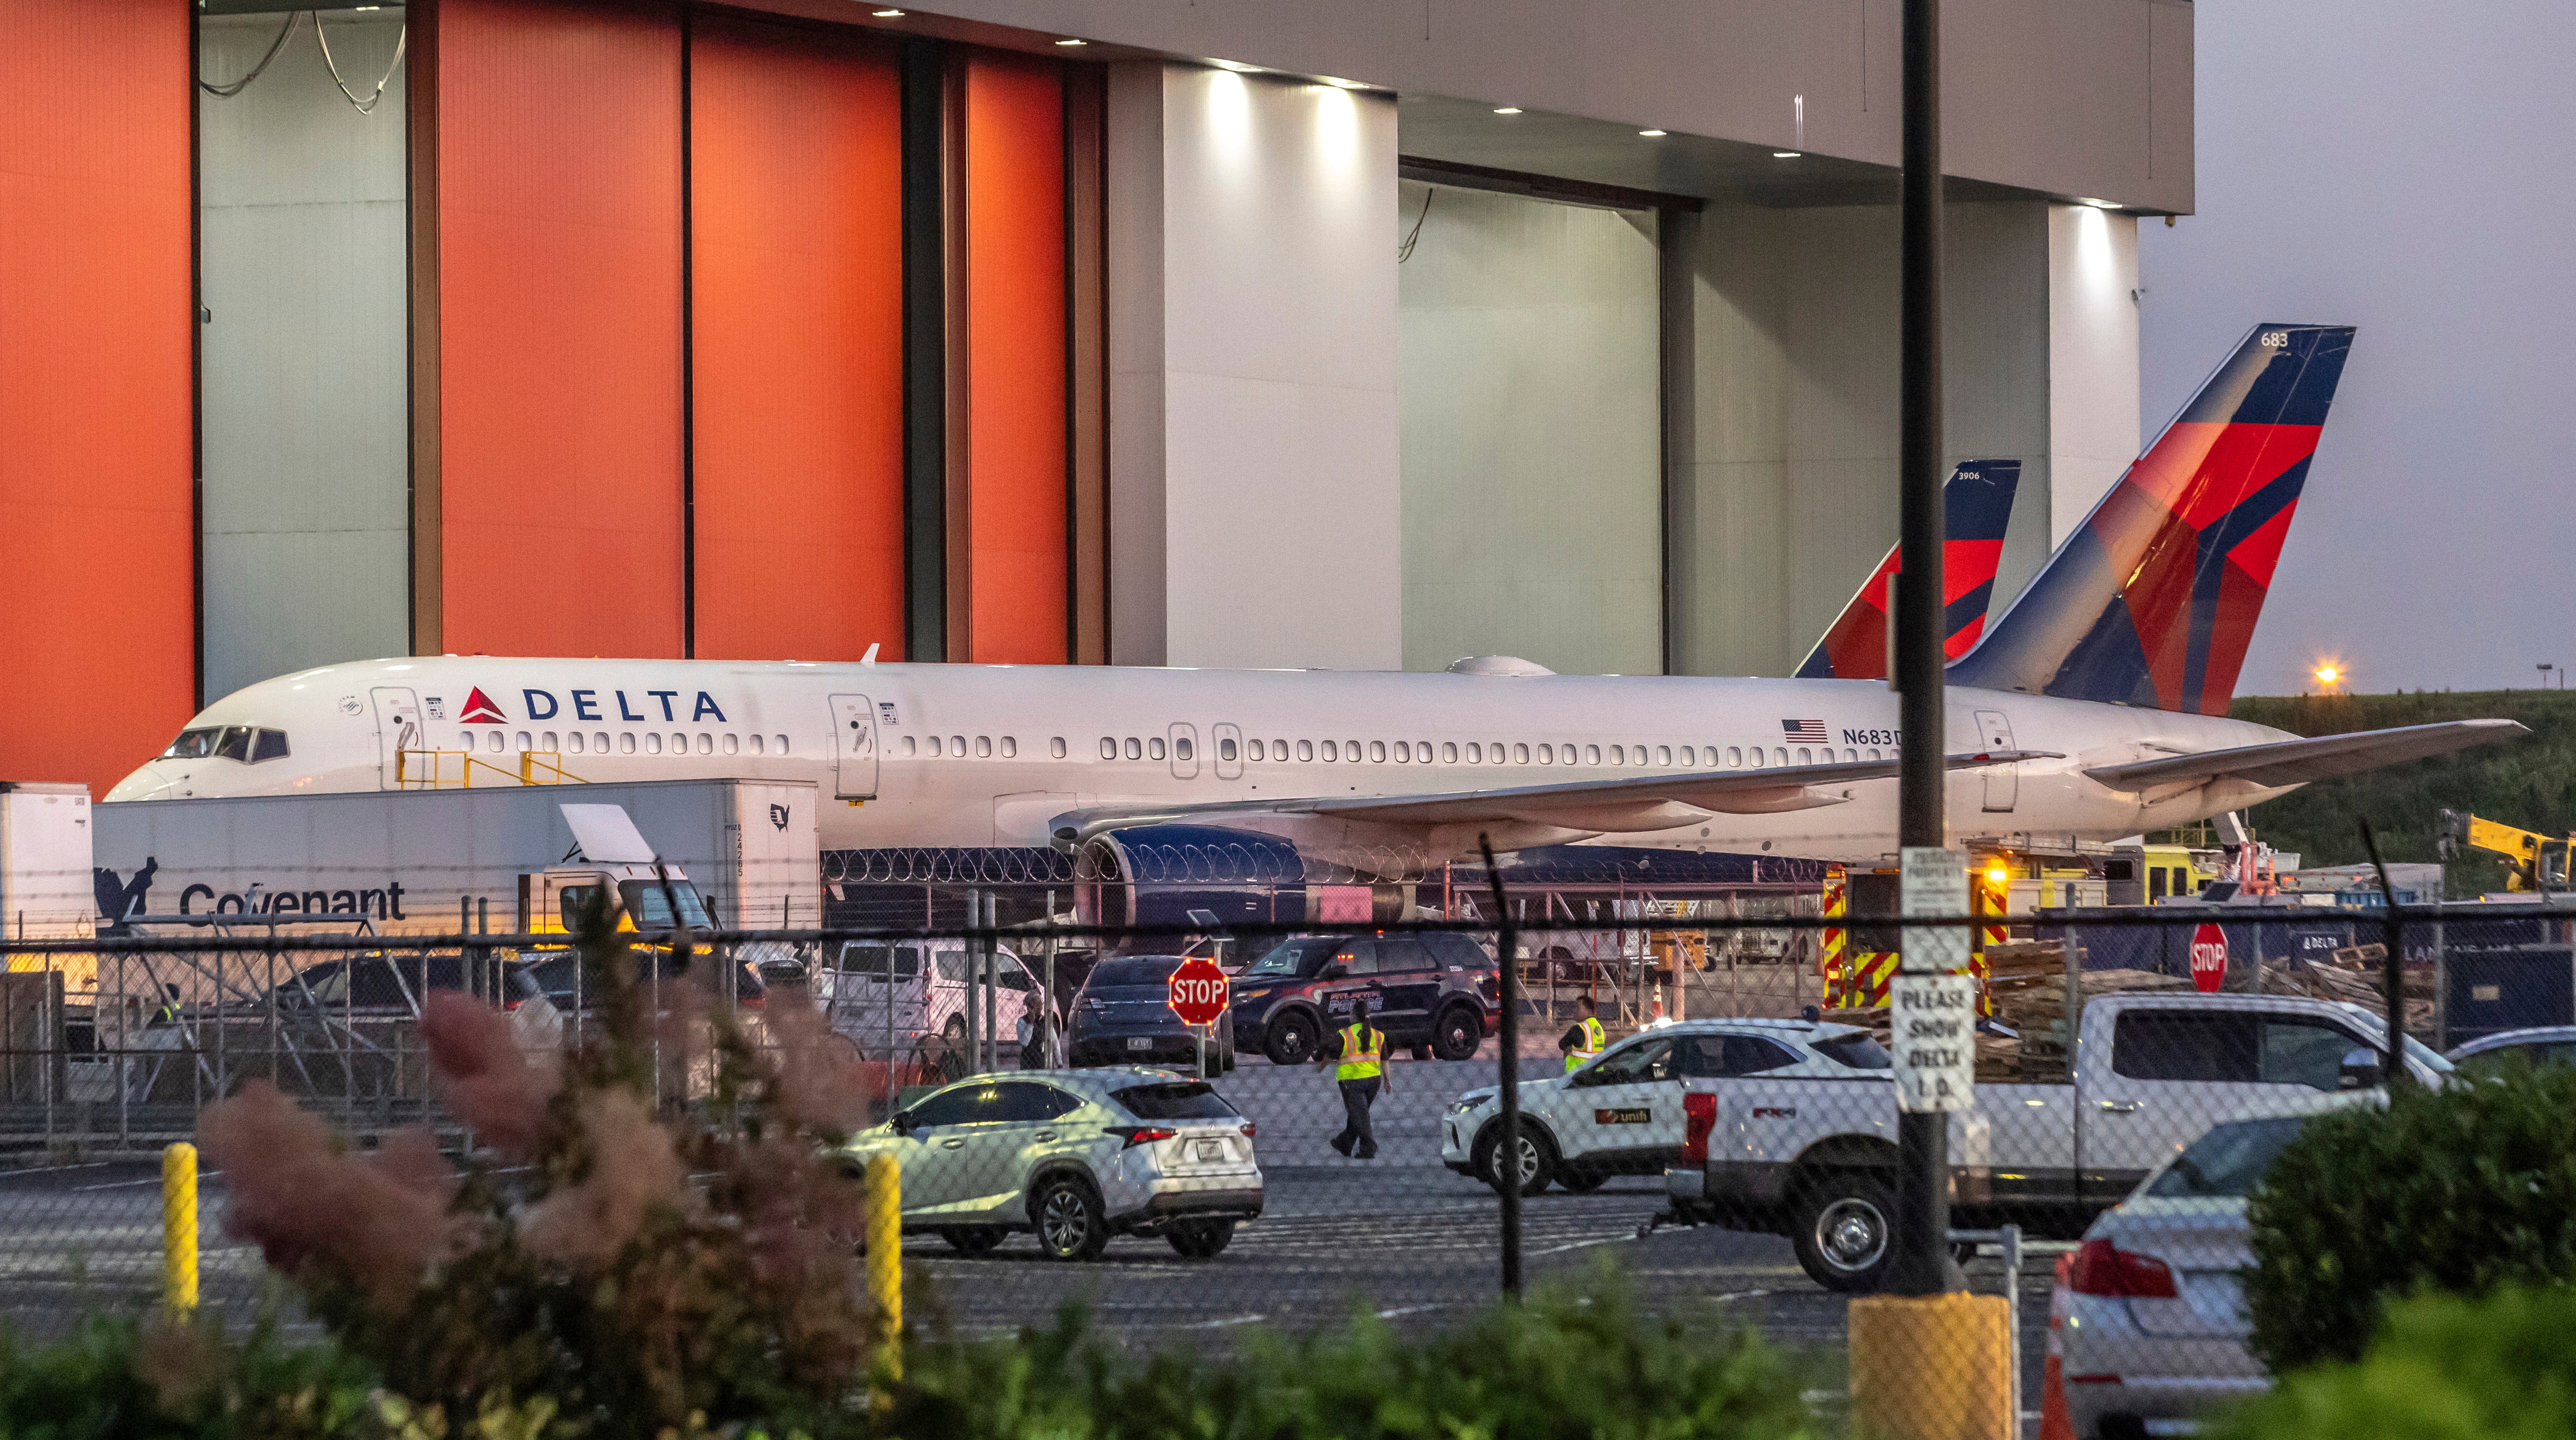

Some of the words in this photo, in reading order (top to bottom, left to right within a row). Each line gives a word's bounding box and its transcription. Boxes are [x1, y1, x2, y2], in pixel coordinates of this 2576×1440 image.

[2261, 332, 2288, 347] 683
[1959, 472, 1980, 480] 3906
[522, 689, 727, 722] DELTA
[2194, 943, 2225, 971] STOP
[1174, 979, 1224, 1004] STOP
[1901, 989, 1965, 1010] PLEASE
[1328, 997, 1384, 1014] POLCE
[1909, 1019, 1961, 1039] SHOW
[1909, 1048, 1960, 1068] DELTA
